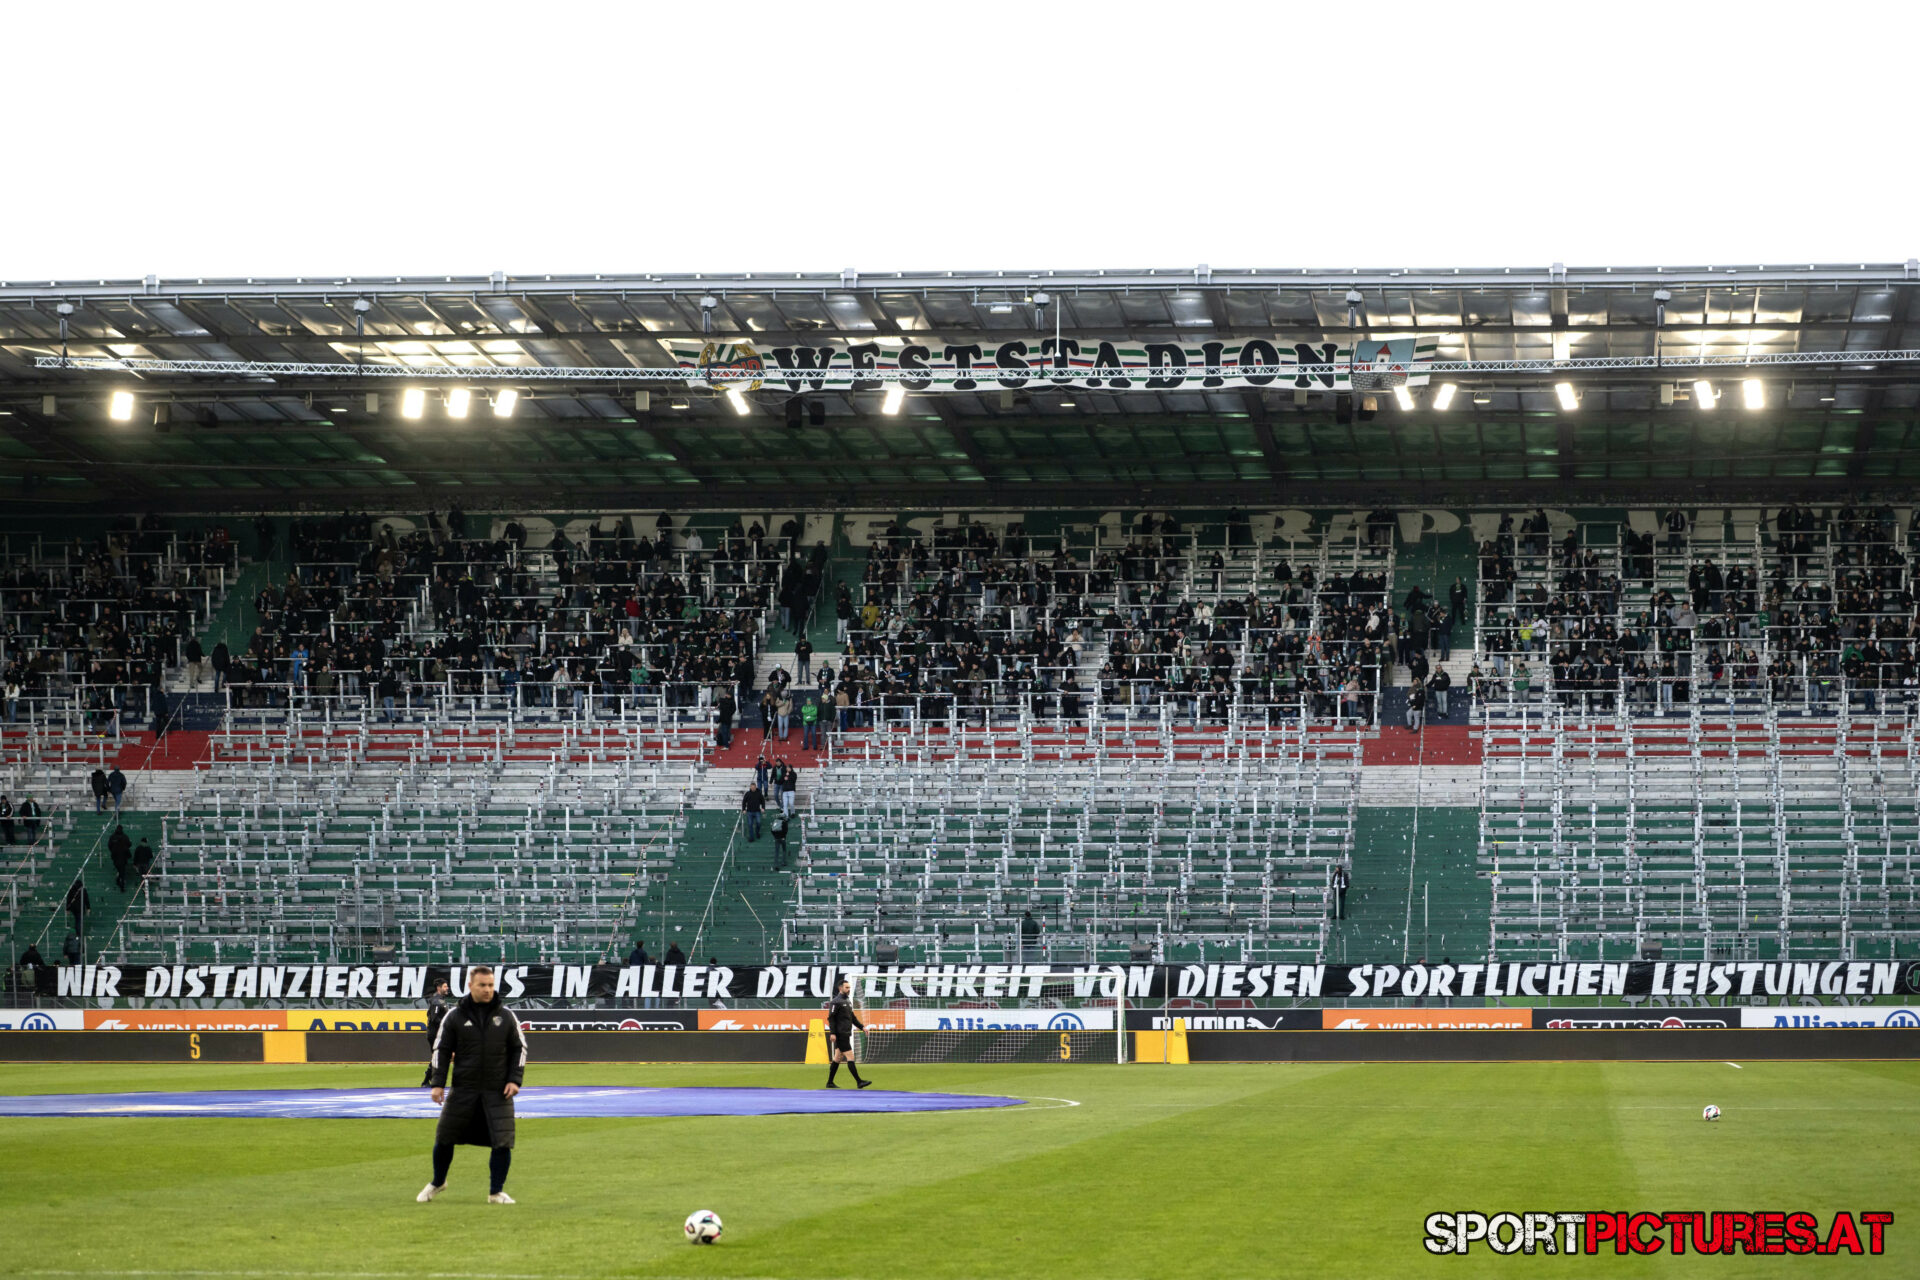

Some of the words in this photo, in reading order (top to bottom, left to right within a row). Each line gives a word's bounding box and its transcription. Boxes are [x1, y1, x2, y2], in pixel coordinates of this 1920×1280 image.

[772, 338, 1338, 391] WESTSTADION
[57, 963, 122, 997] WIR
[145, 964, 427, 998] DISTANZIEREN
[551, 964, 592, 998] IN
[616, 964, 734, 998] ALLER
[757, 963, 1050, 998] DEUTLICHKEIT
[1073, 963, 1155, 997] VON
[1178, 963, 1326, 997] DIESEN
[1348, 962, 1629, 997] SPORTLICHEN
[1651, 961, 1900, 995] LEISTUNGEN
